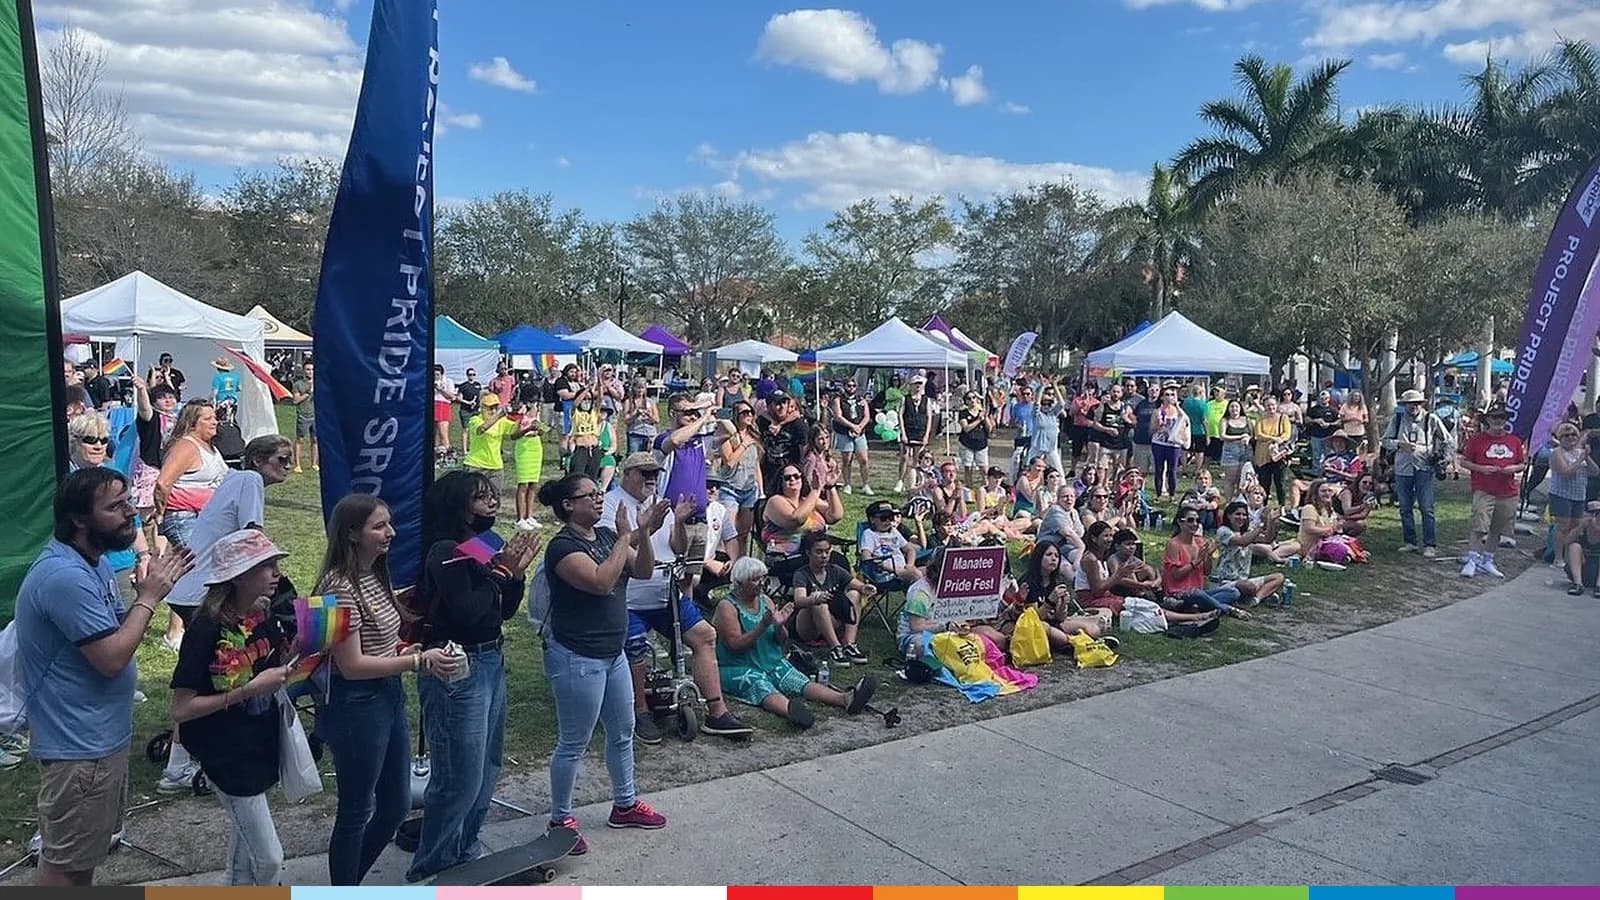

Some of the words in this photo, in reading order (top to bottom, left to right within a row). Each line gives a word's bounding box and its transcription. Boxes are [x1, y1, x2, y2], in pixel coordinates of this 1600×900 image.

[1535, 235, 1580, 332] PROJECT
[374, 264, 422, 404] PRIDE
[1512, 332, 1541, 394] PRIDE
[944, 579, 971, 592] Pride
[973, 577, 994, 590] Fest
[952, 557, 994, 570] Manatee
